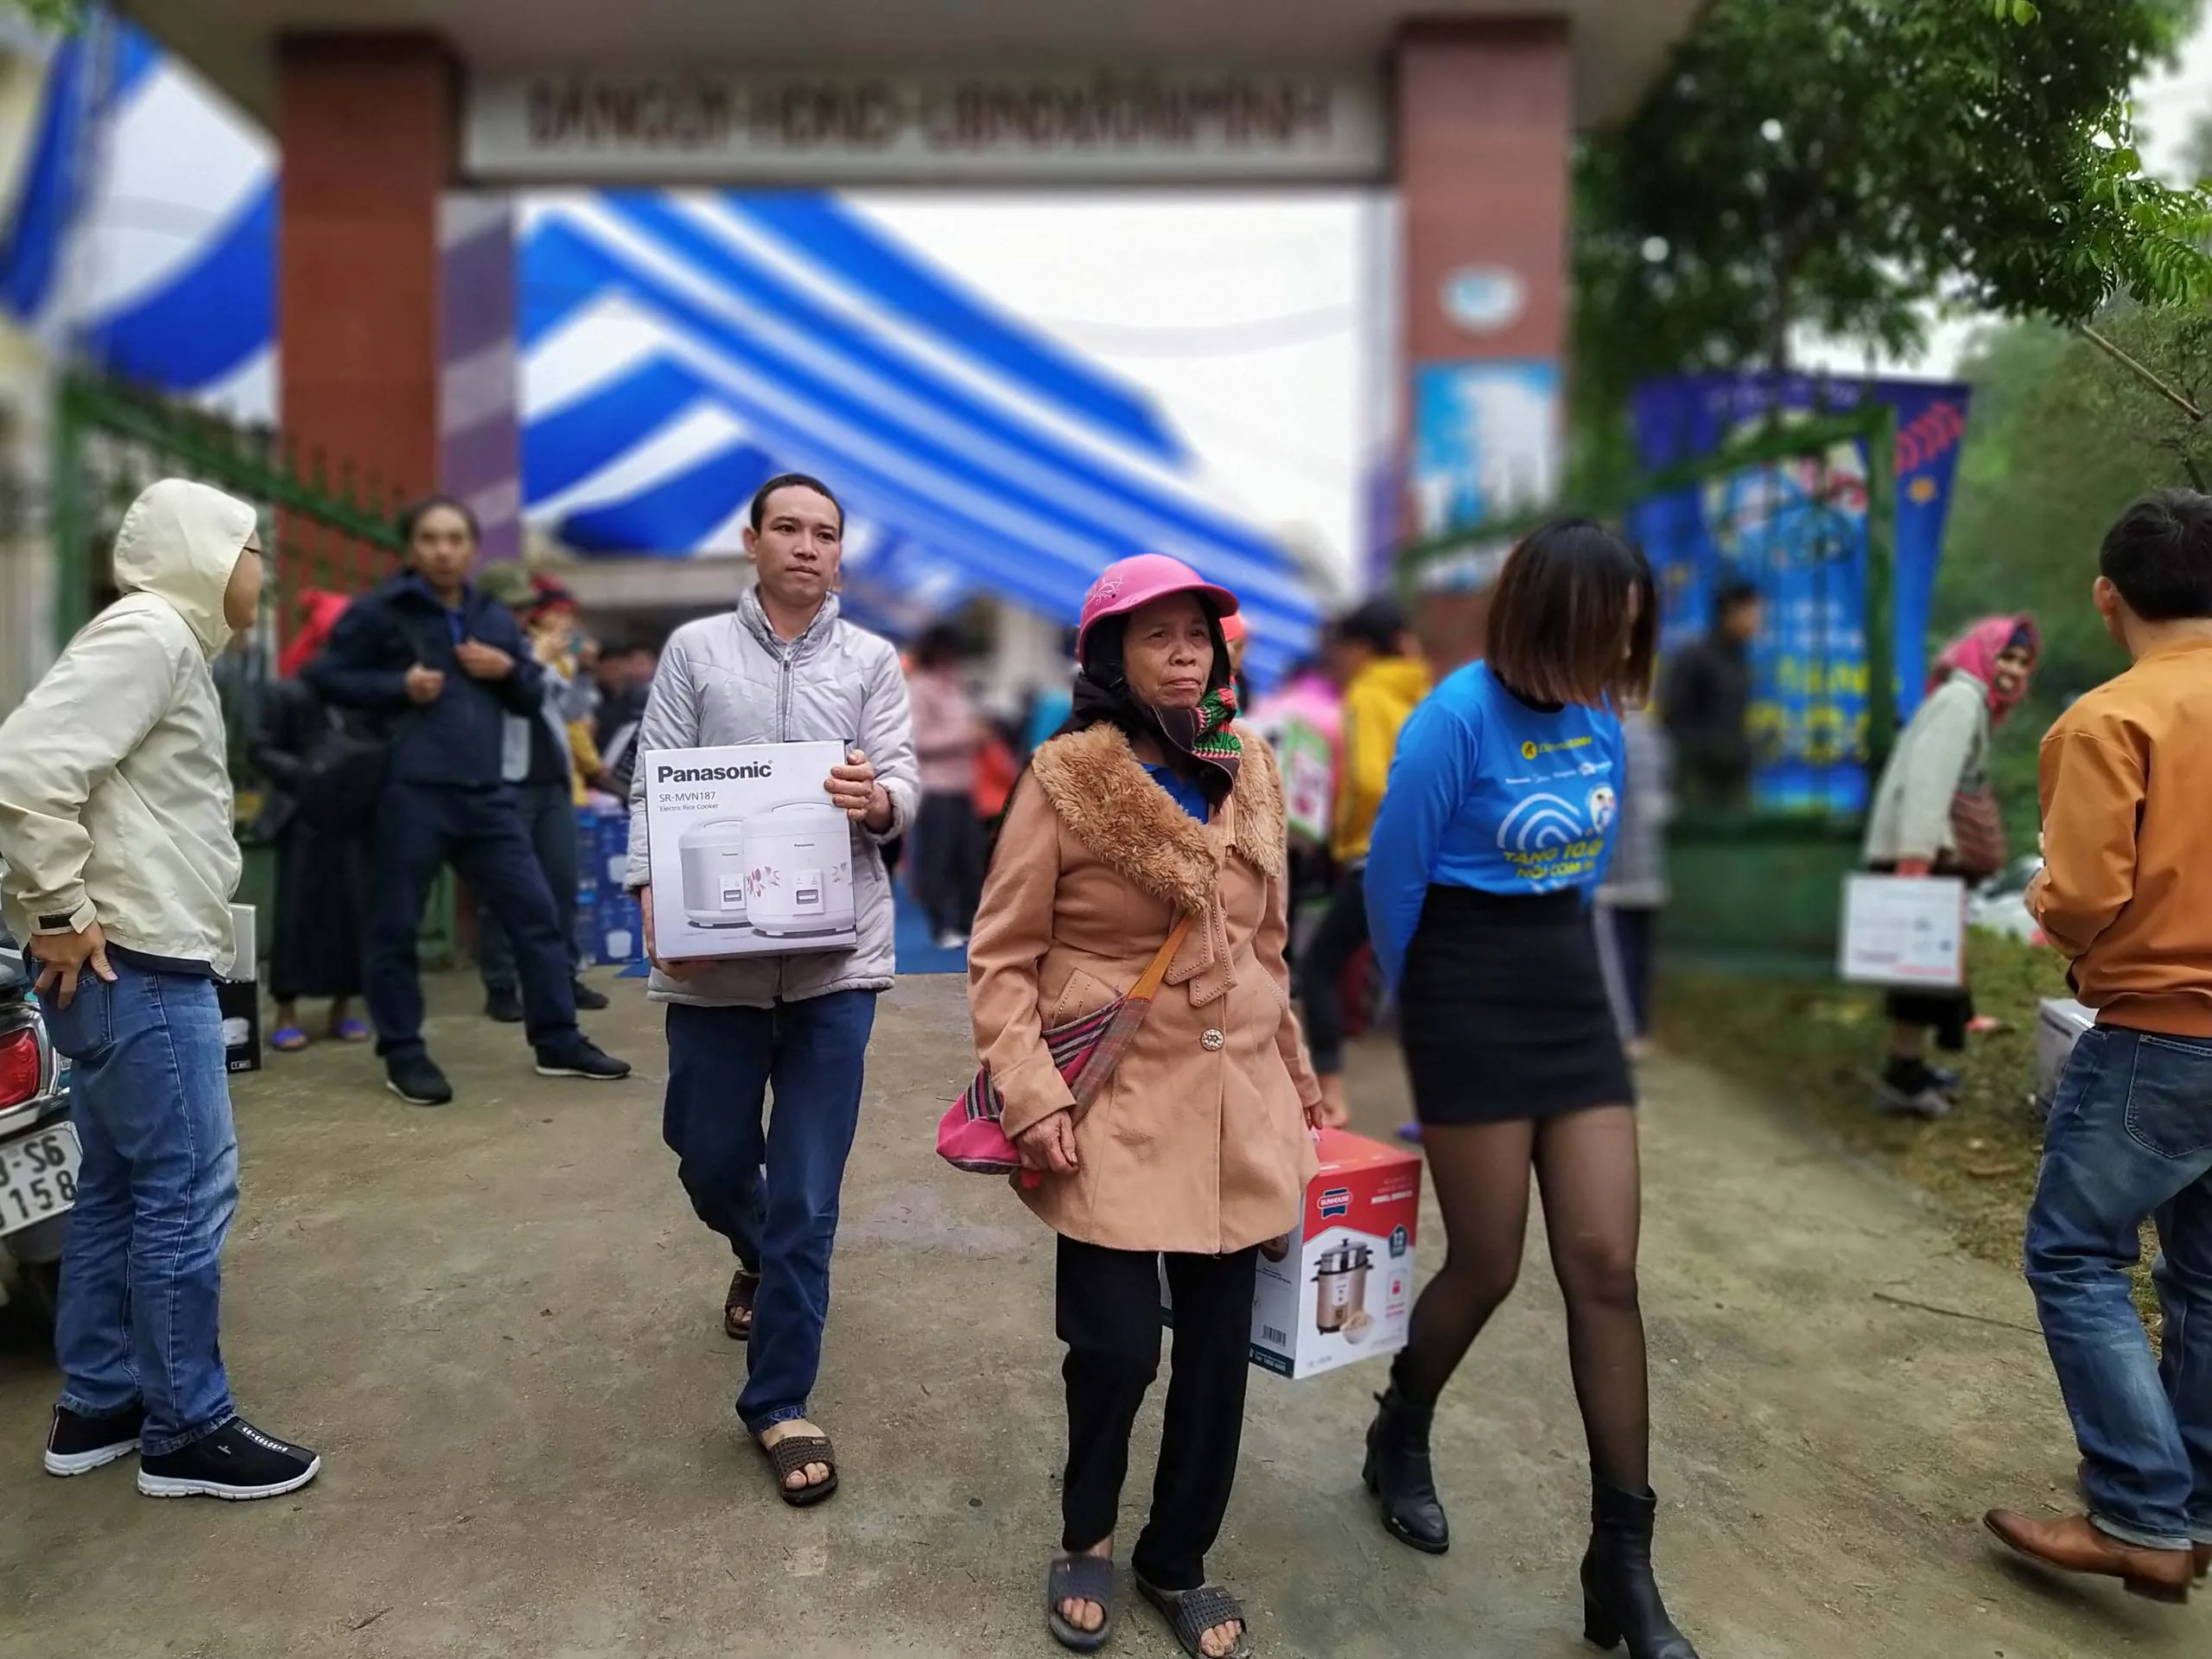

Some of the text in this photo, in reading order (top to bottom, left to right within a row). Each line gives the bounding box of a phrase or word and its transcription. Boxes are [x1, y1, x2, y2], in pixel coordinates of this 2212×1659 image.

[658, 761, 772, 783] Panasonic
[659, 791, 716, 802] SR-MVN187
[0, 1168, 76, 1228] 158
